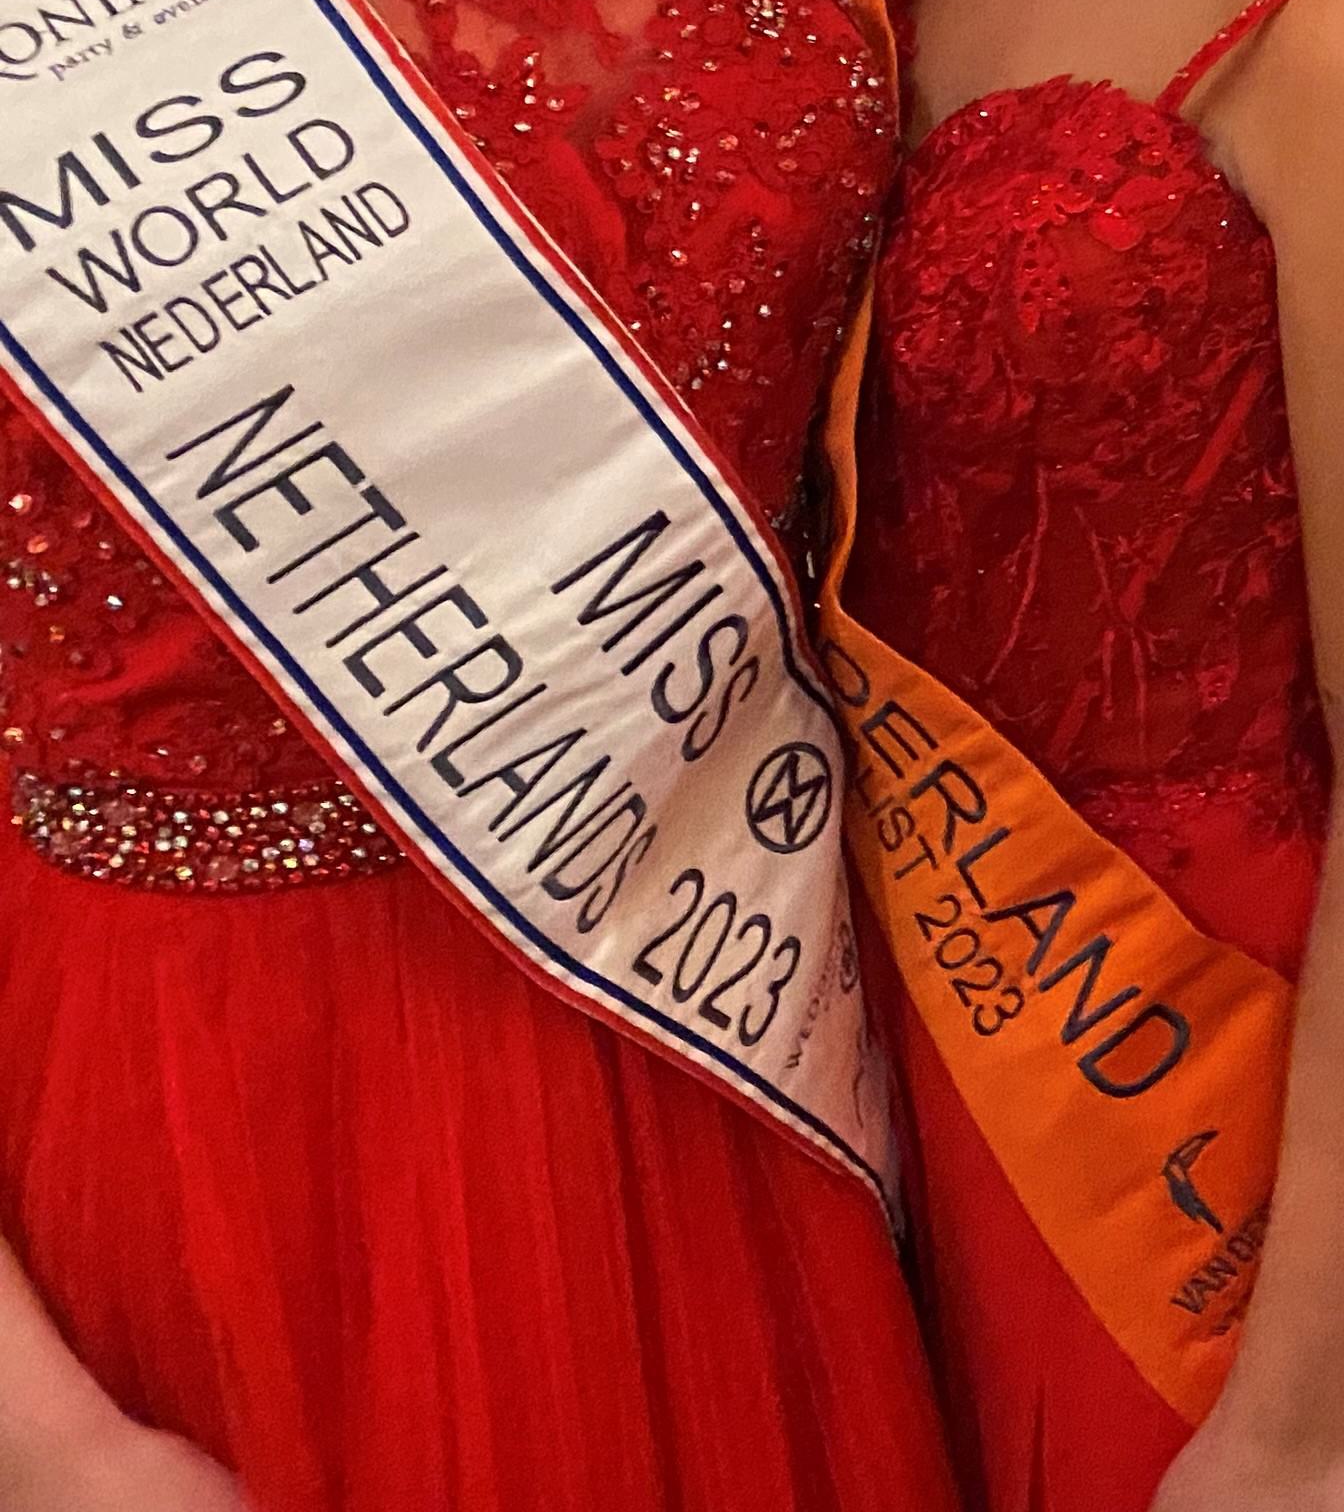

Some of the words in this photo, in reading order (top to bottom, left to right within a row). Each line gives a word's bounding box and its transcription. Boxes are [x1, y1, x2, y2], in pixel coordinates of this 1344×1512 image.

[0, 50, 307, 252] MISS
[49, 38, 113, 81] party
[121, 22, 145, 39] &
[45, 118, 355, 314] WORLD
[98, 181, 410, 393] NEDERLAND
[166, 384, 656, 934] NETHERLANDS
[631, 868, 801, 1047] 2023
[550, 509, 760, 762] MISS
[914, 893, 1025, 1036] 2023
